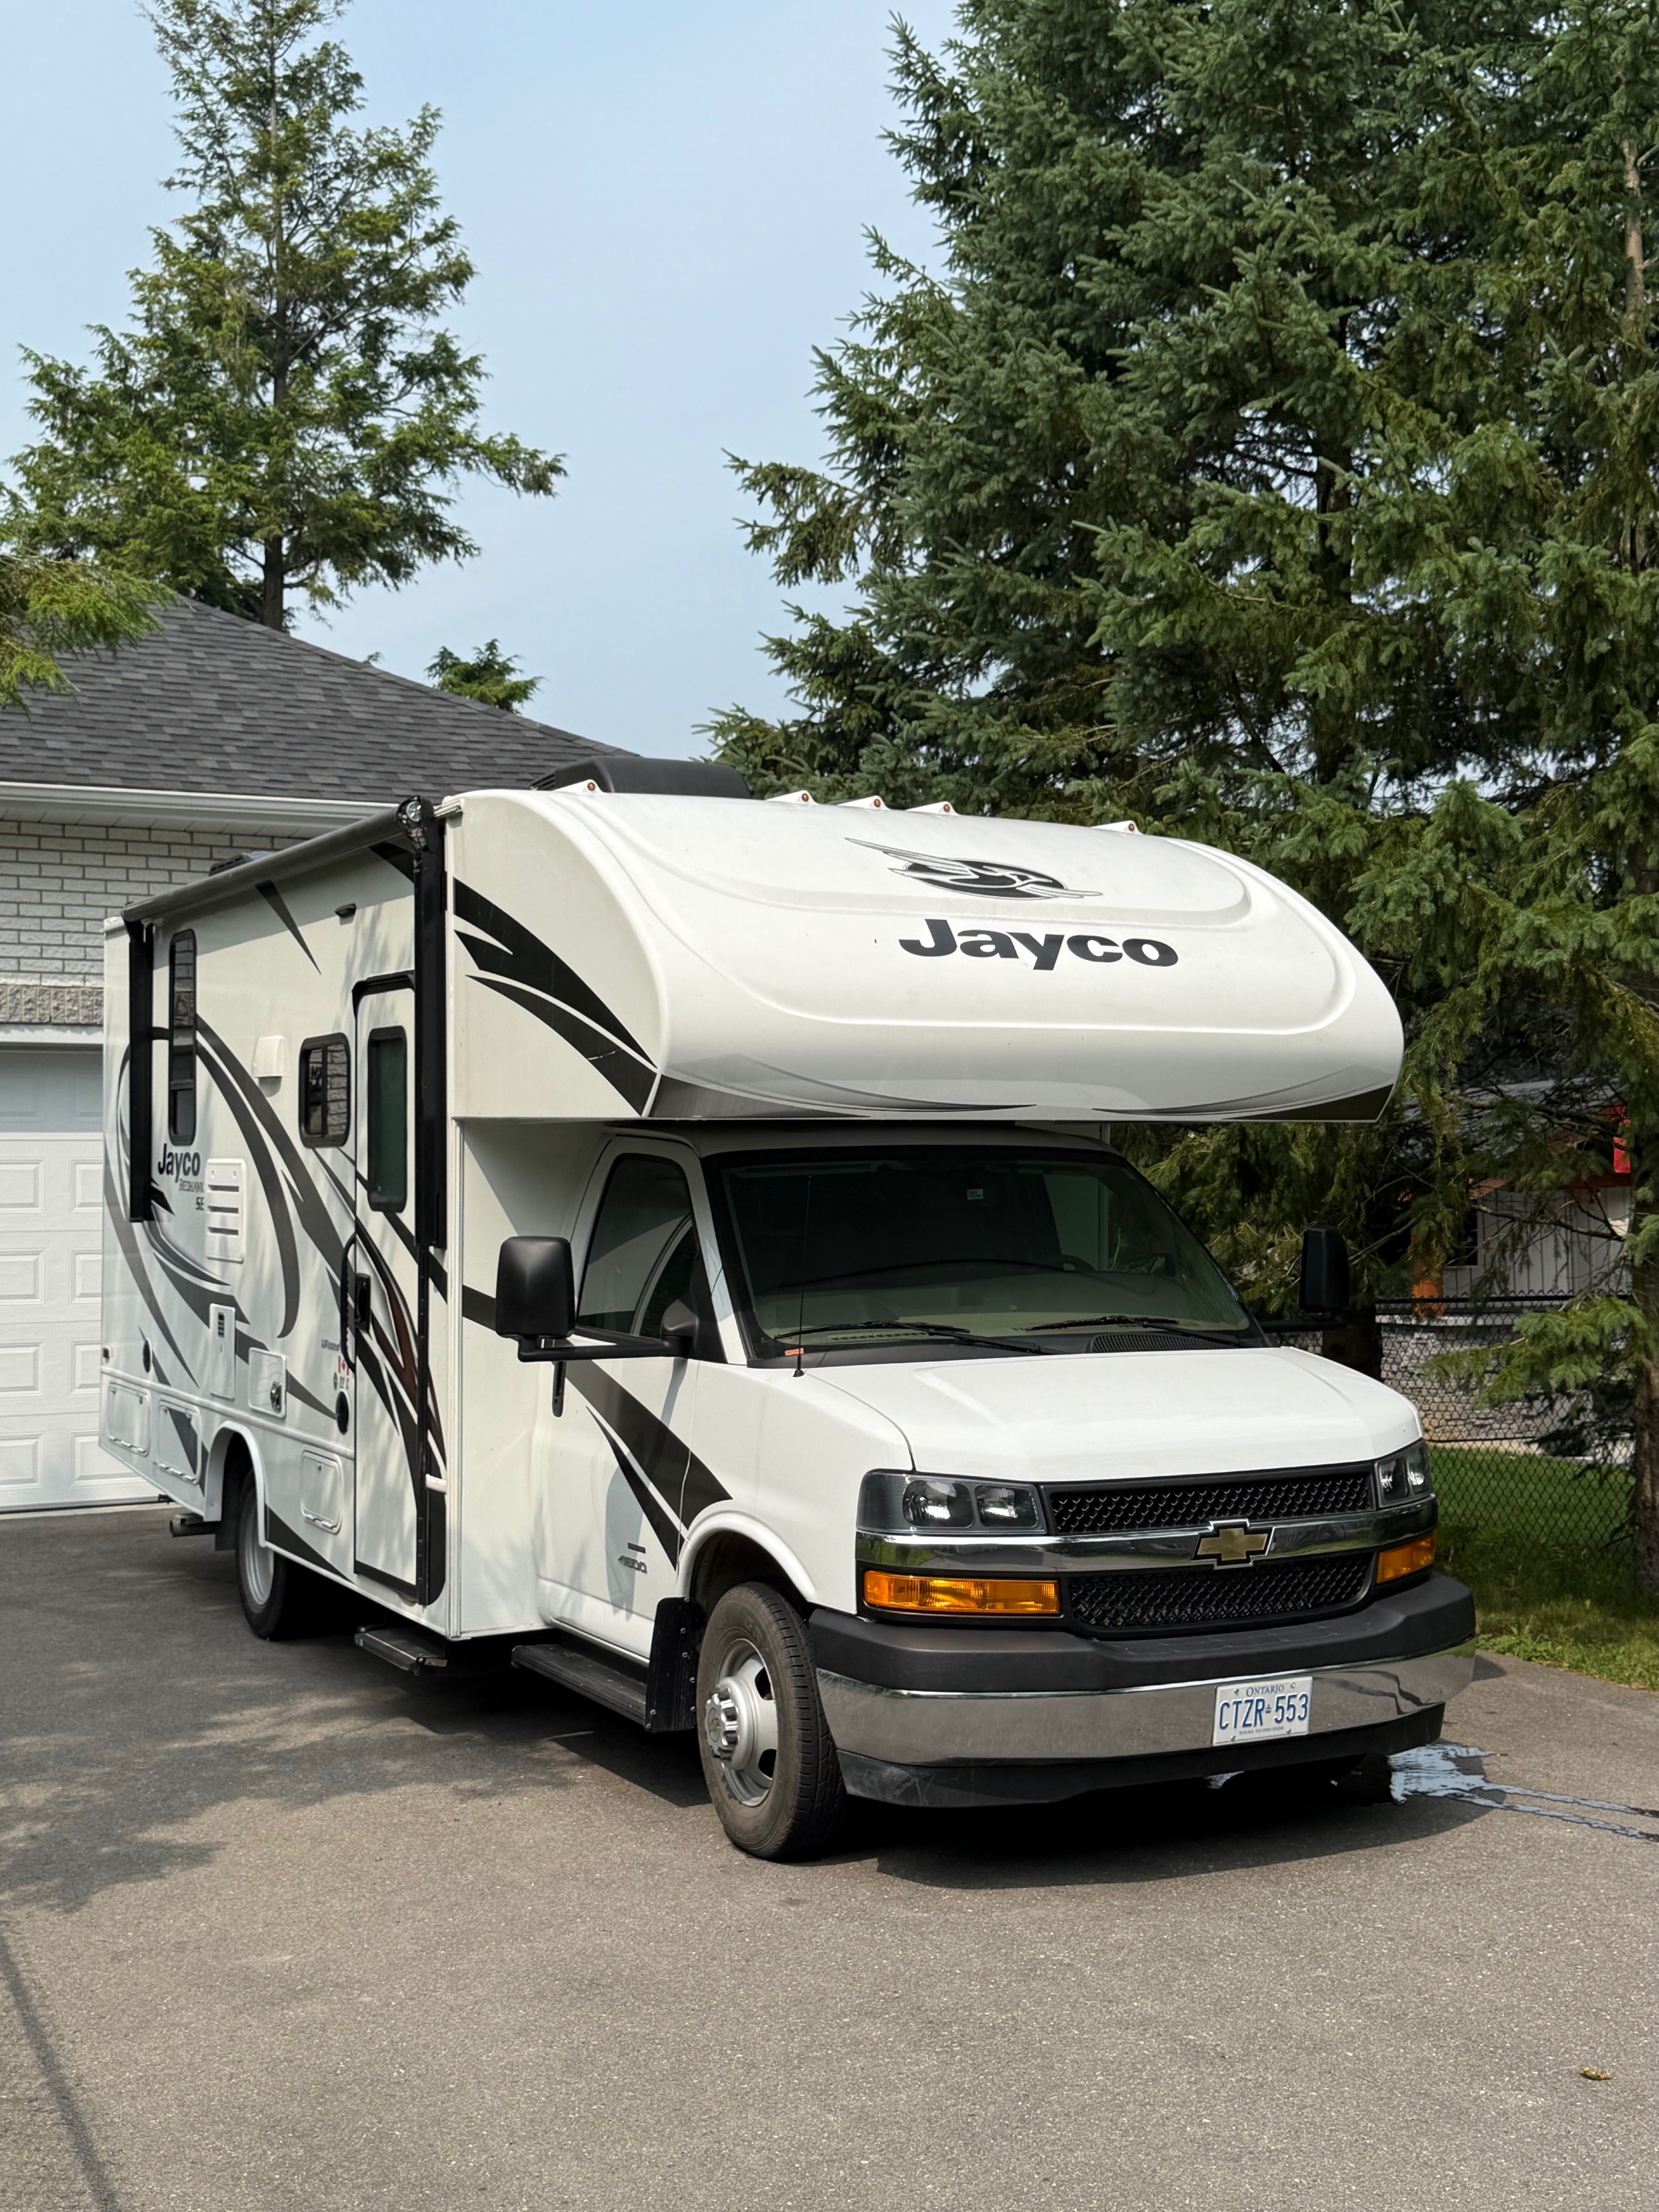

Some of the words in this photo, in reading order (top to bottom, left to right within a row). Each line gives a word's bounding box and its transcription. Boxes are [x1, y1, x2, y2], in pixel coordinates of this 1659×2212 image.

[899, 919, 1178, 971] Jayco
[158, 1143, 201, 1183] Jayco
[1246, 1685, 1284, 1696] ONTARIO
[1219, 1698, 1265, 1729] CTZR
[1274, 1694, 1308, 1723] 553
